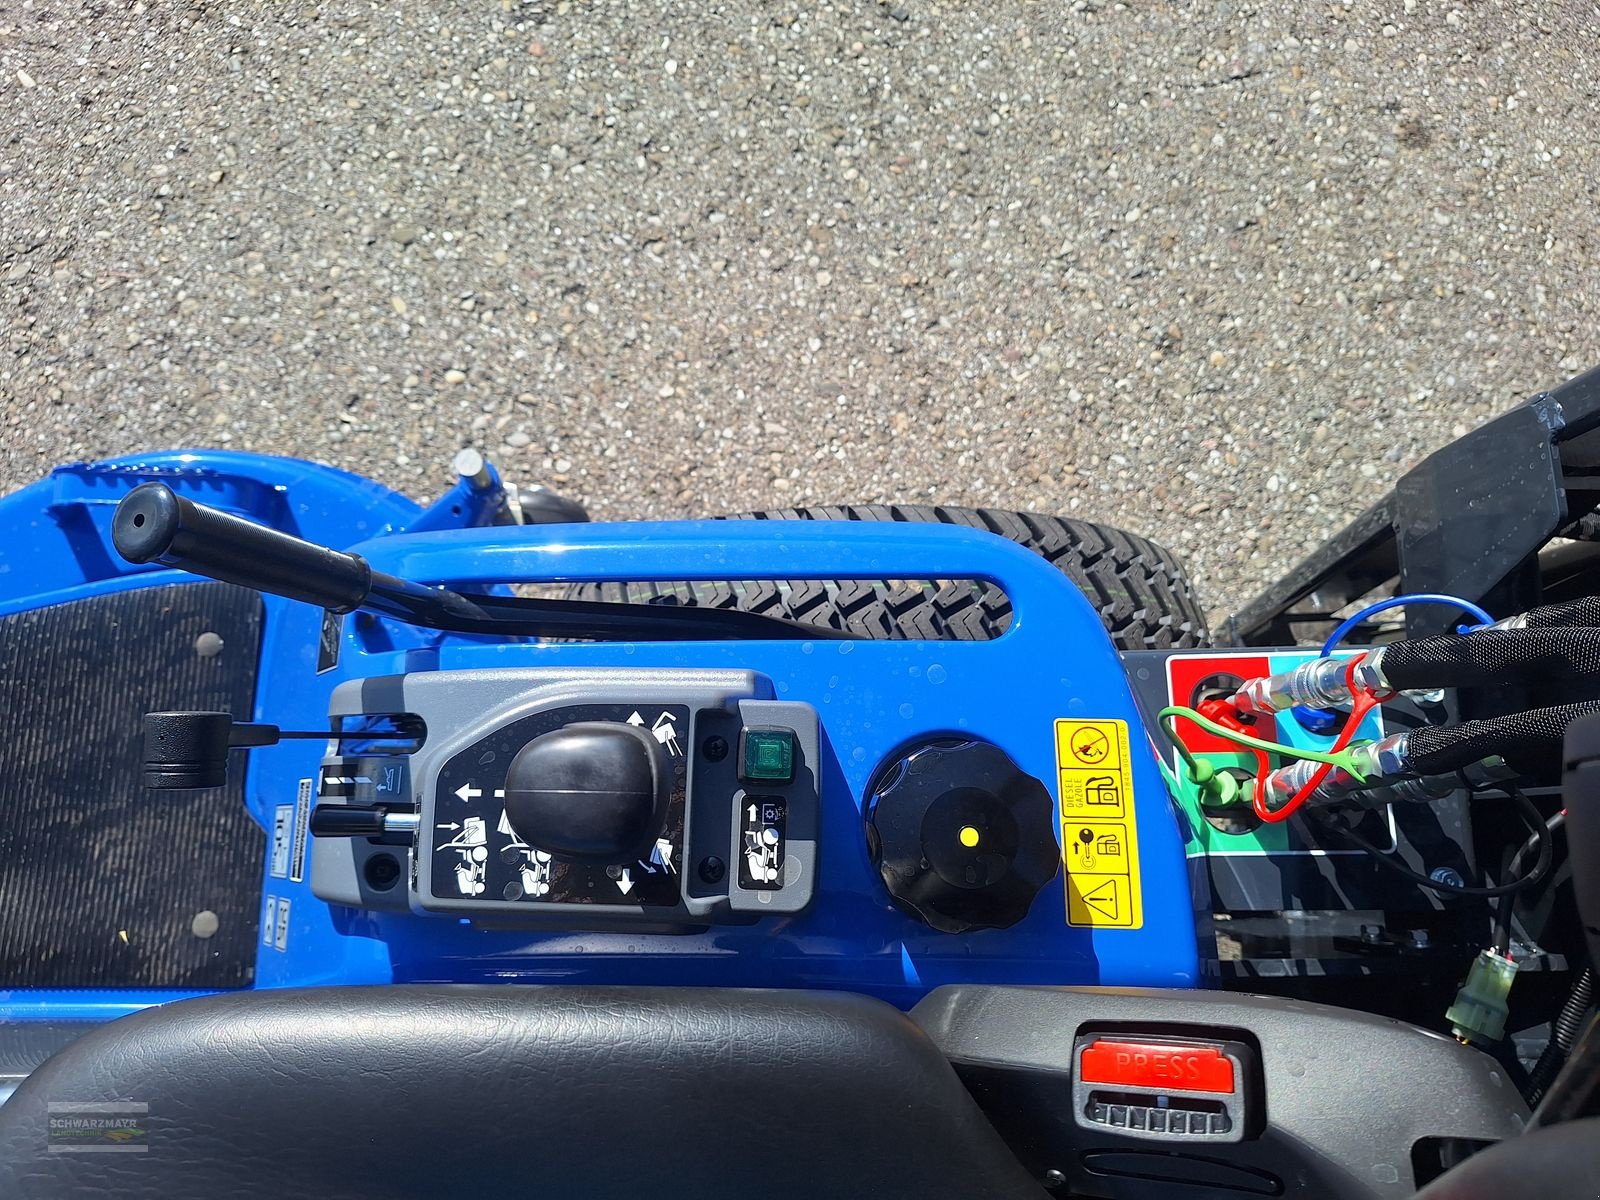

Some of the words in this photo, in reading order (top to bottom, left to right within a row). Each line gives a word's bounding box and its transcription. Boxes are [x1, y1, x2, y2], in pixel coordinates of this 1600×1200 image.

[1065, 778, 1075, 808] DIESEL
[1074, 778, 1084, 808] GAZOLE
[1116, 1053, 1199, 1079] PRESS
